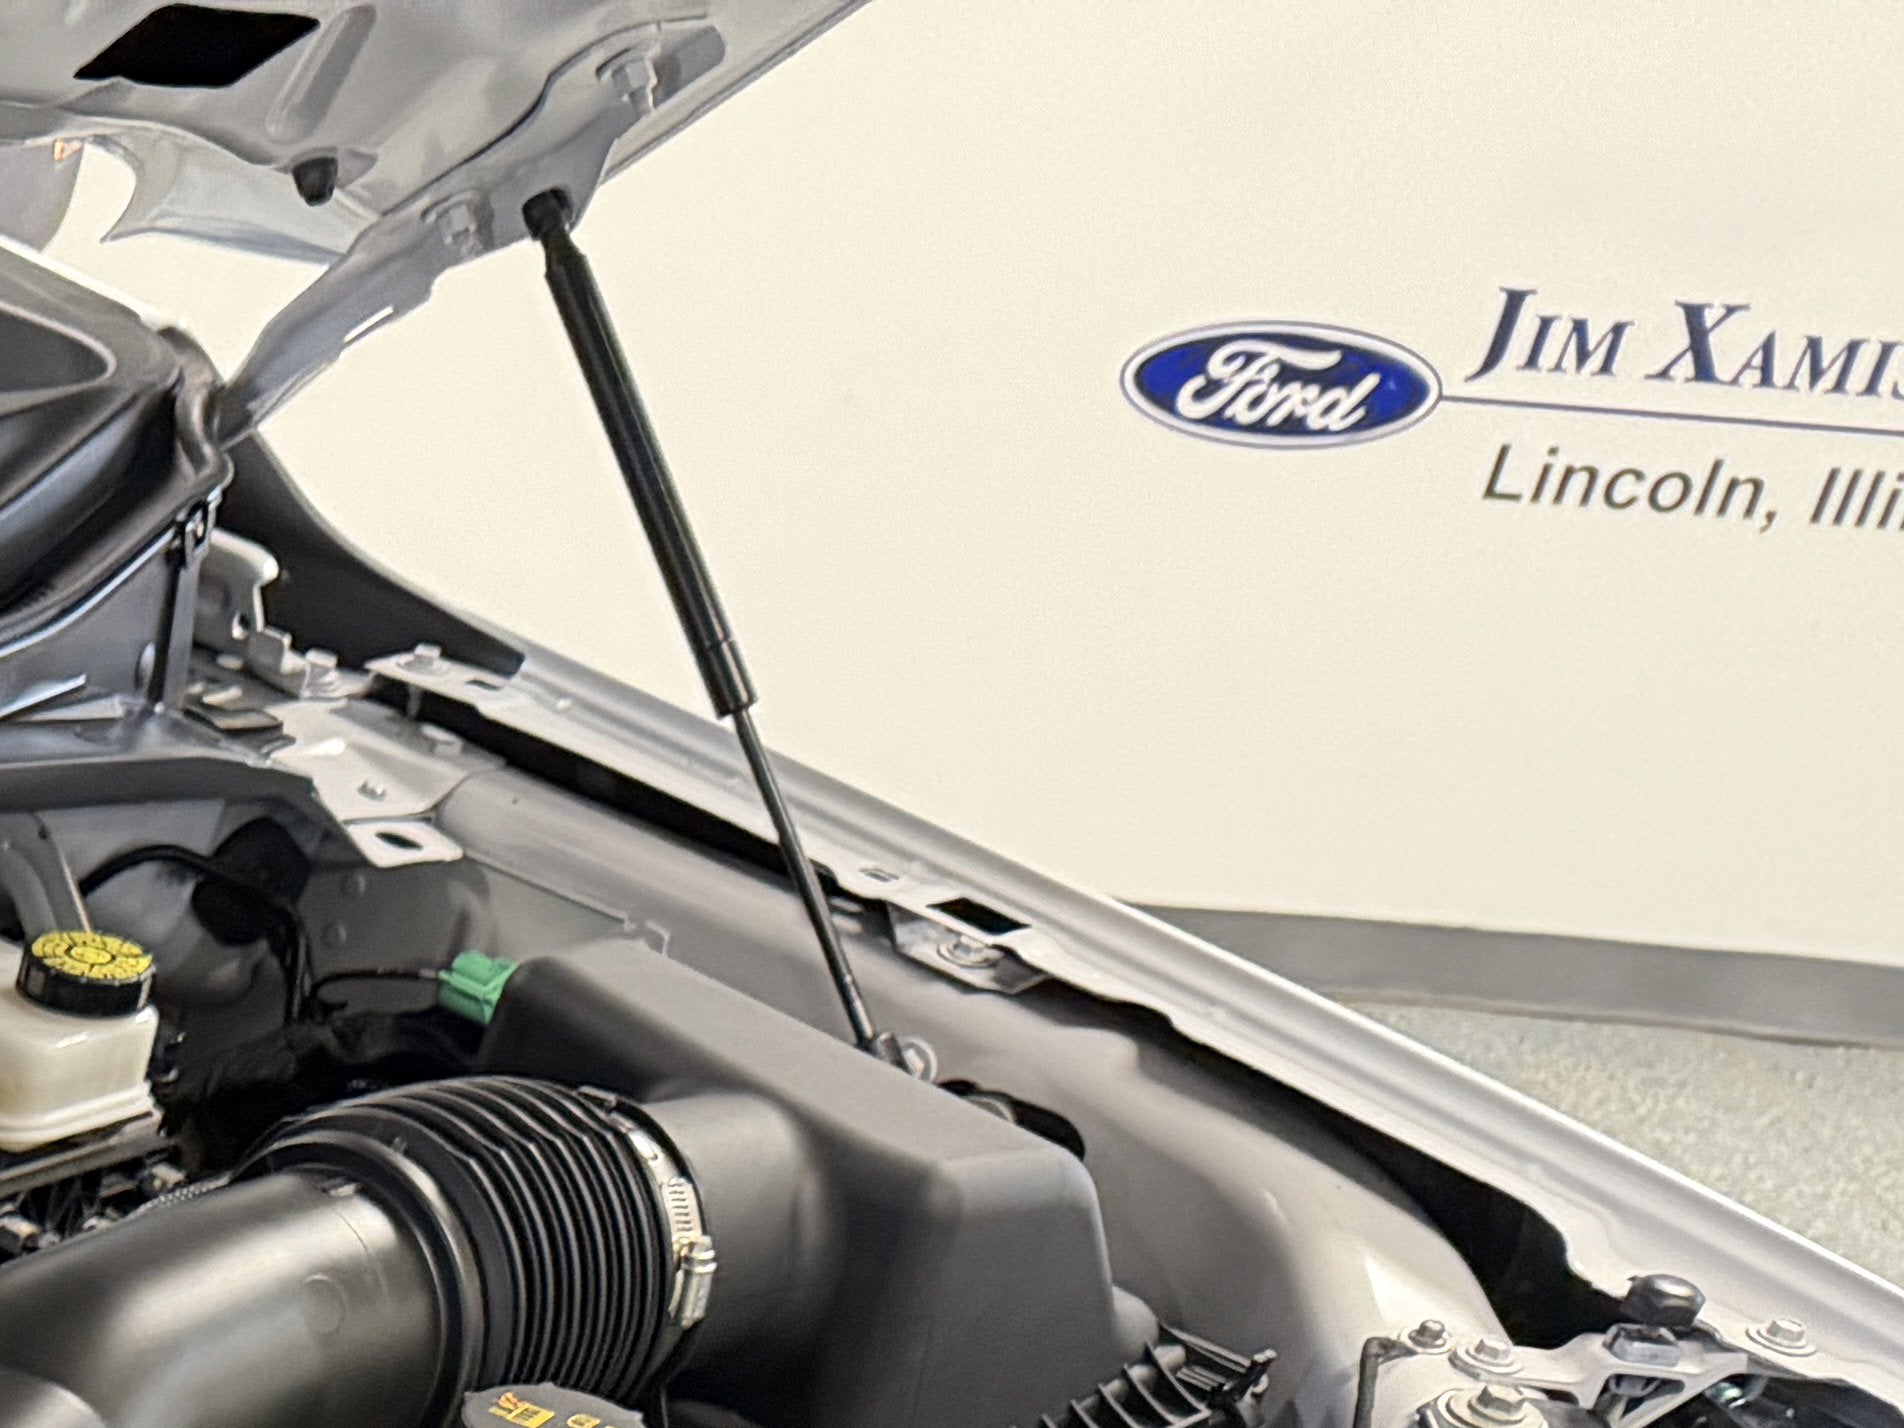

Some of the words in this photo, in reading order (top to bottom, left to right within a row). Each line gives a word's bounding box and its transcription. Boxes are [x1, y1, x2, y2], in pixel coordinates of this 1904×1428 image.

[1466, 287, 1635, 381] JIM
[1176, 339, 1381, 432] Ford
[1483, 444, 1778, 530] Lincoln,
[1810, 467, 1904, 532] Illi
